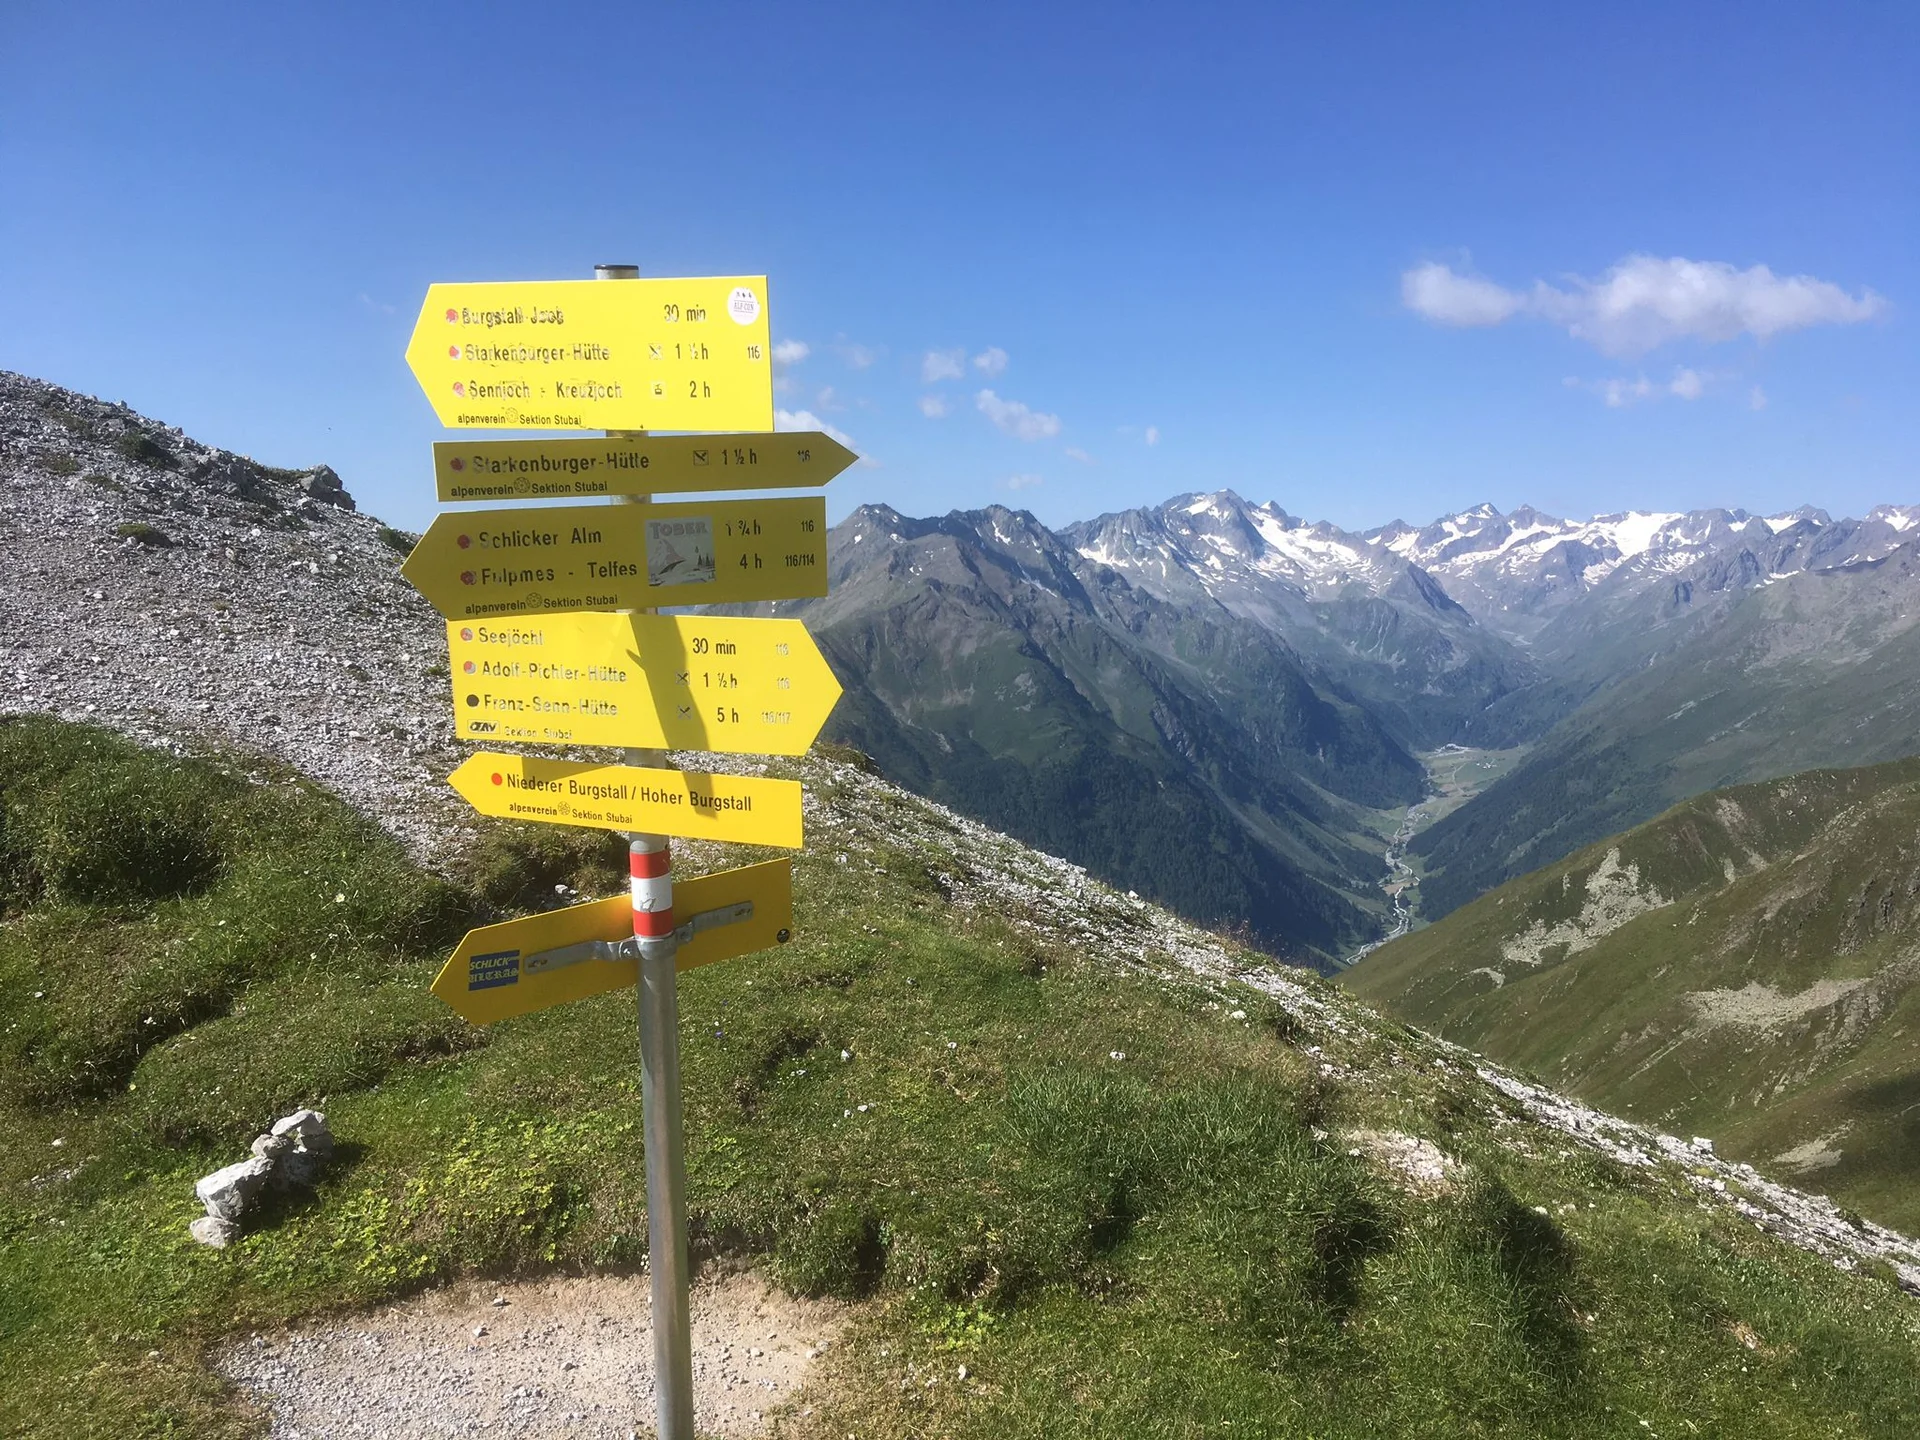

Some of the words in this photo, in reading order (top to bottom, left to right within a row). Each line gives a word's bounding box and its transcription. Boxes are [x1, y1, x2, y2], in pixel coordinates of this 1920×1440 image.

[664, 304, 679, 322] 30
[686, 304, 706, 322] min
[675, 343, 681, 360] 1
[701, 343, 709, 360] h
[747, 345, 761, 359] 116
[469, 380, 530, 401] Sennjoch
[556, 380, 622, 401] Kreuzjoch
[689, 380, 697, 398] 2
[704, 381, 711, 398] h
[458, 413, 506, 425] alpenverein
[519, 414, 551, 425] Sektion
[554, 414, 581, 425] Stubai
[472, 452, 650, 474] Starkenburger-Hütte
[722, 449, 728, 465] 1
[750, 448, 757, 464] h
[451, 485, 514, 498] alpenverein
[531, 482, 571, 494] Sektion
[575, 481, 607, 492] Stubai
[753, 519, 761, 535] h
[801, 520, 814, 532] 116
[479, 530, 559, 549] Schlicker
[571, 527, 602, 545] Alm
[739, 553, 748, 569] 4
[755, 553, 762, 568] h
[785, 554, 815, 567] 116/114
[482, 567, 555, 587] Fulpmes
[587, 561, 637, 578] Telfes
[465, 600, 526, 614] alpenverein
[543, 597, 583, 609] Sektion
[586, 594, 618, 606] Stubai
[478, 627, 544, 647] Seejöchl
[692, 638, 709, 654] 30
[715, 639, 736, 655] min
[482, 661, 627, 683] Adolf-Pichler-Hütte
[703, 672, 709, 688] 1
[730, 673, 738, 688] h
[484, 694, 618, 716] Franz-Senn-Hütte
[717, 707, 725, 723] 5
[731, 707, 739, 723] h
[507, 773, 562, 793] Niederer
[569, 780, 627, 800] Burgstall
[641, 788, 683, 805] Hoher
[690, 792, 751, 811] Burgstall
[509, 803, 557, 816] alpenverein
[572, 808, 603, 821] Sektion
[606, 812, 632, 824] Stubai
